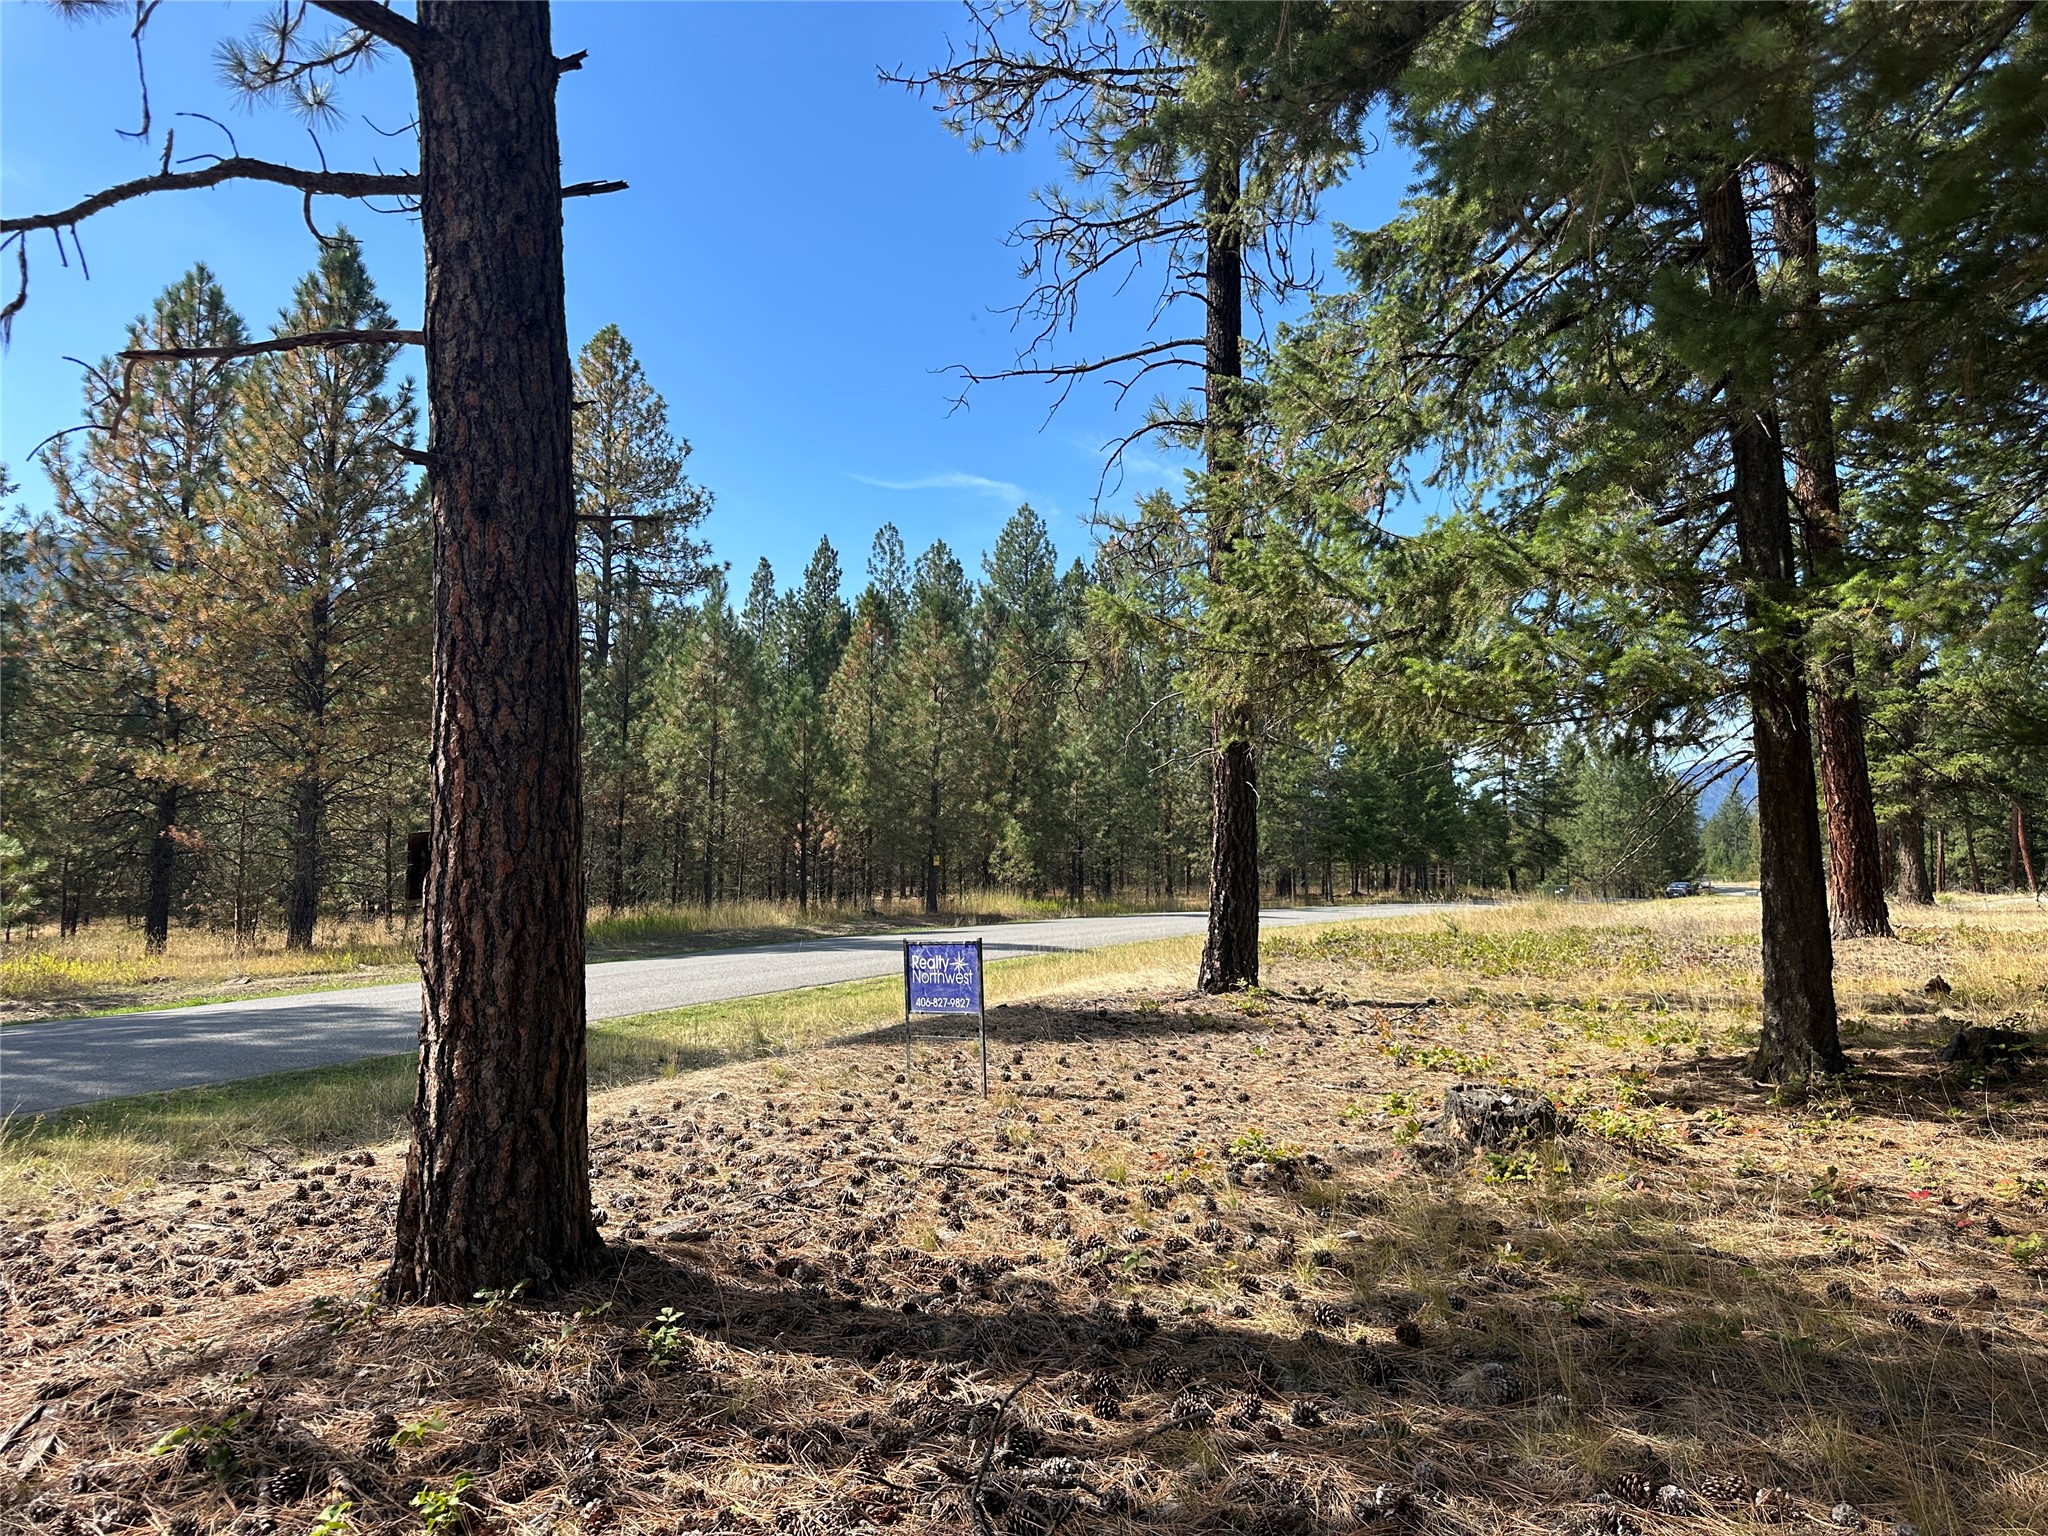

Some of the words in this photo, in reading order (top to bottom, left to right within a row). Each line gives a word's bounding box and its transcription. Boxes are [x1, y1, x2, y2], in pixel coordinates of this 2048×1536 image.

[912, 955, 949, 972] Realty
[912, 969, 973, 984] Northwest
[916, 997, 970, 1008] 406-827-9827
